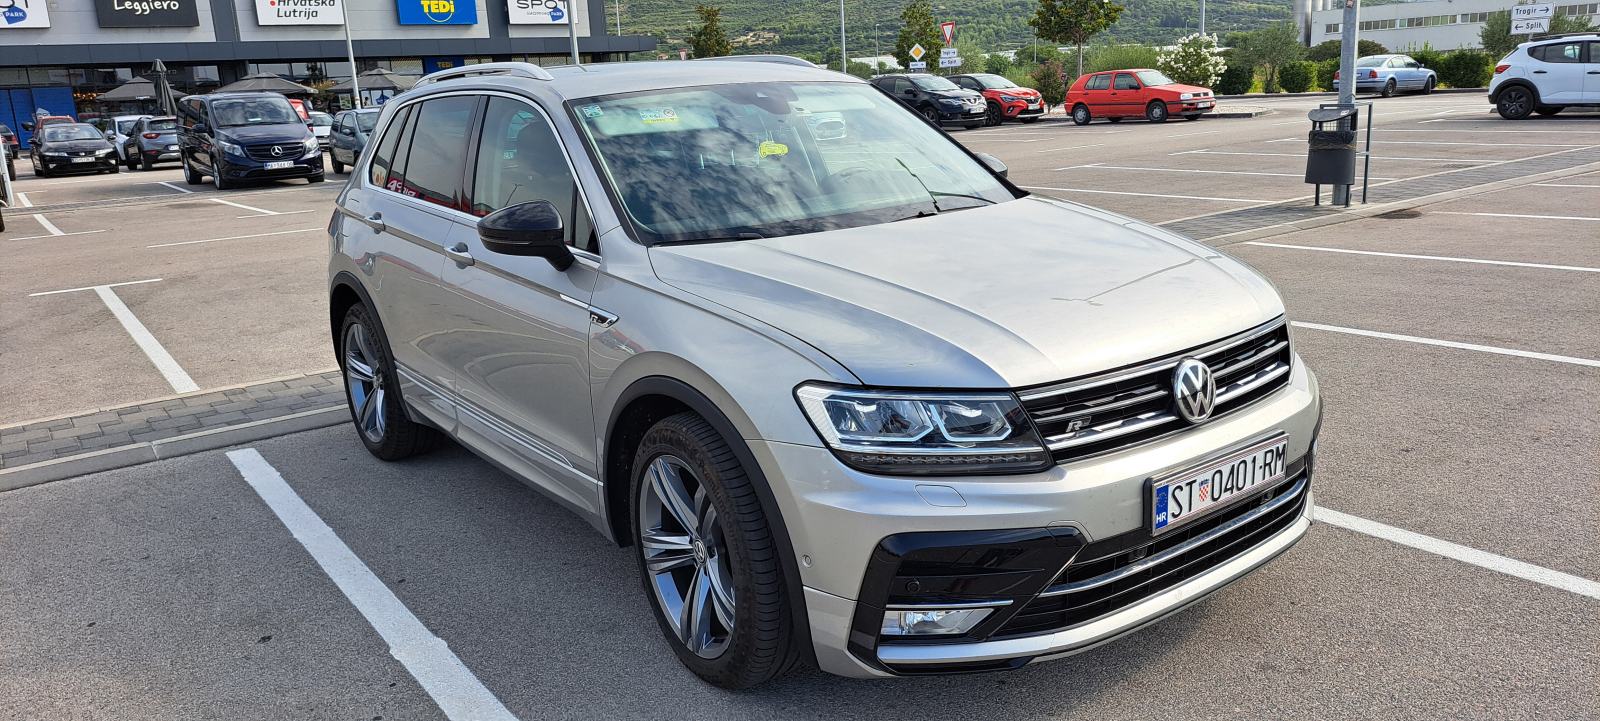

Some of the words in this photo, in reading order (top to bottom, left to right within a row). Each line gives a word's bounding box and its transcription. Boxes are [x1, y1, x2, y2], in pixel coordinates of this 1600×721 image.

[113, 0, 179, 15] Leggiero
[421, 0, 455, 13] TEDi
[516, 0, 567, 9] SPOT
[277, 8, 319, 20] Lutrija
[1515, 7, 1537, 15] Trogir
[1525, 22, 1541, 30] Split
[1171, 479, 1197, 519] ST
[1156, 511, 1167, 524] HR
